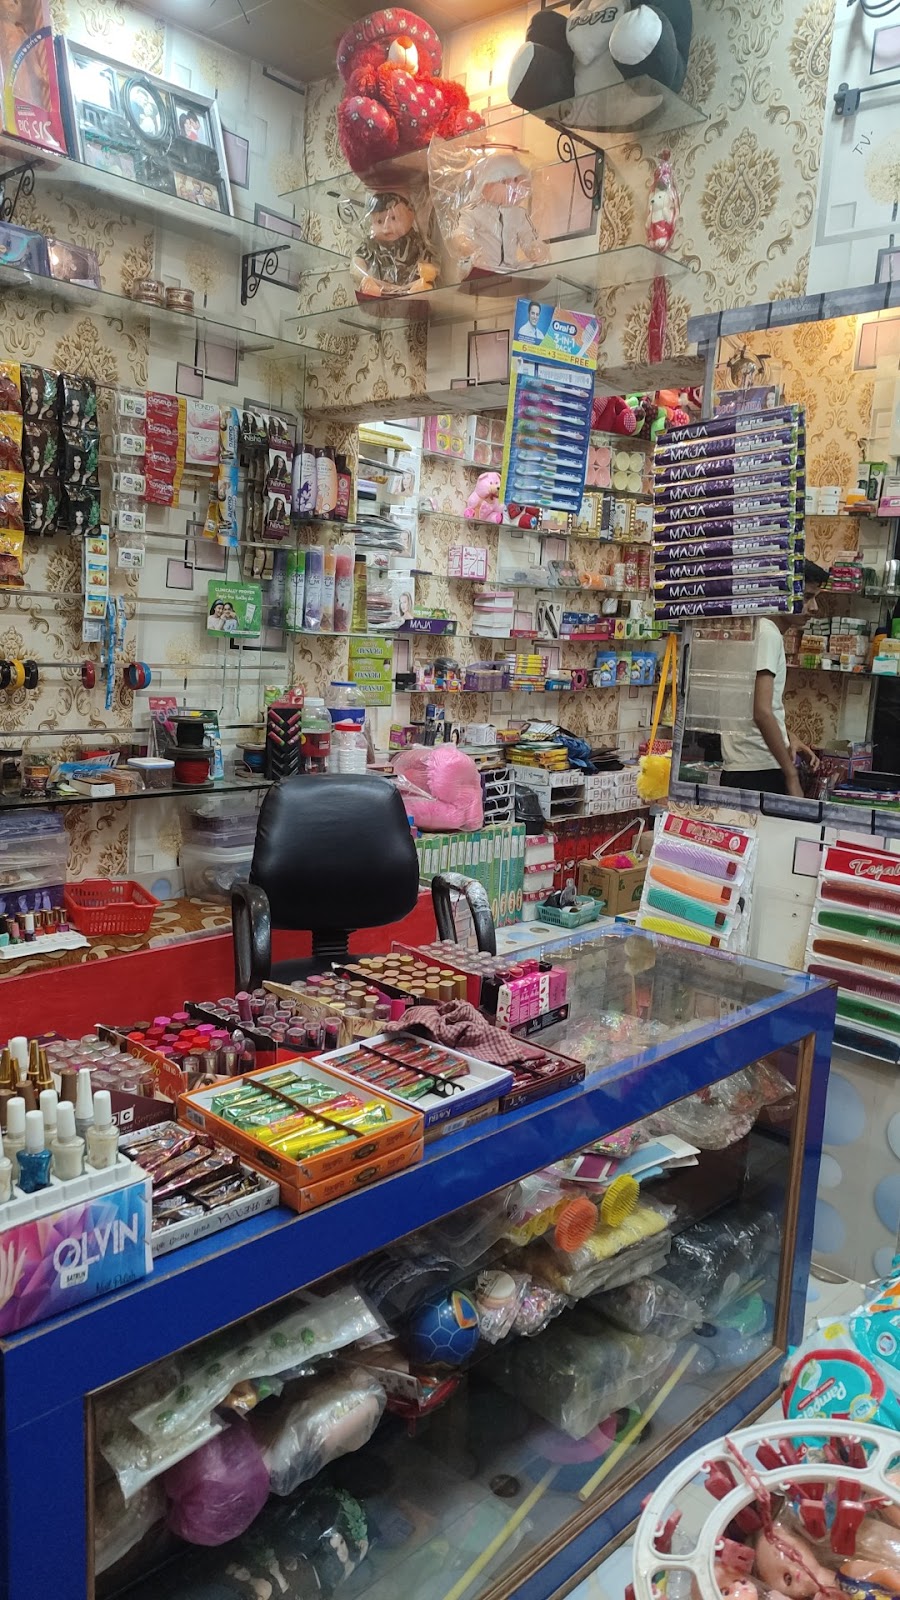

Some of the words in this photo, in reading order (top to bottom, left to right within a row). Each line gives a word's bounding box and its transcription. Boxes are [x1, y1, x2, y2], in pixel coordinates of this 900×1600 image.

[553, 322, 577, 335] Oral-B
[521, 344, 528, 352] 6
[570, 355, 590, 367] FREE
[671, 426, 708, 442] MAJA
[670, 446, 707, 461] MAJA
[669, 466, 706, 481] MAJA
[669, 486, 706, 501] MAJA
[669, 506, 706, 520] MAJA
[669, 526, 706, 539] MAJA
[669, 545, 706, 559] MAJA
[669, 565, 705, 578] MAJA
[669, 584, 705, 597] MAJA
[669, 604, 705, 616] MAJA
[410, 620, 432, 630] MAJA
